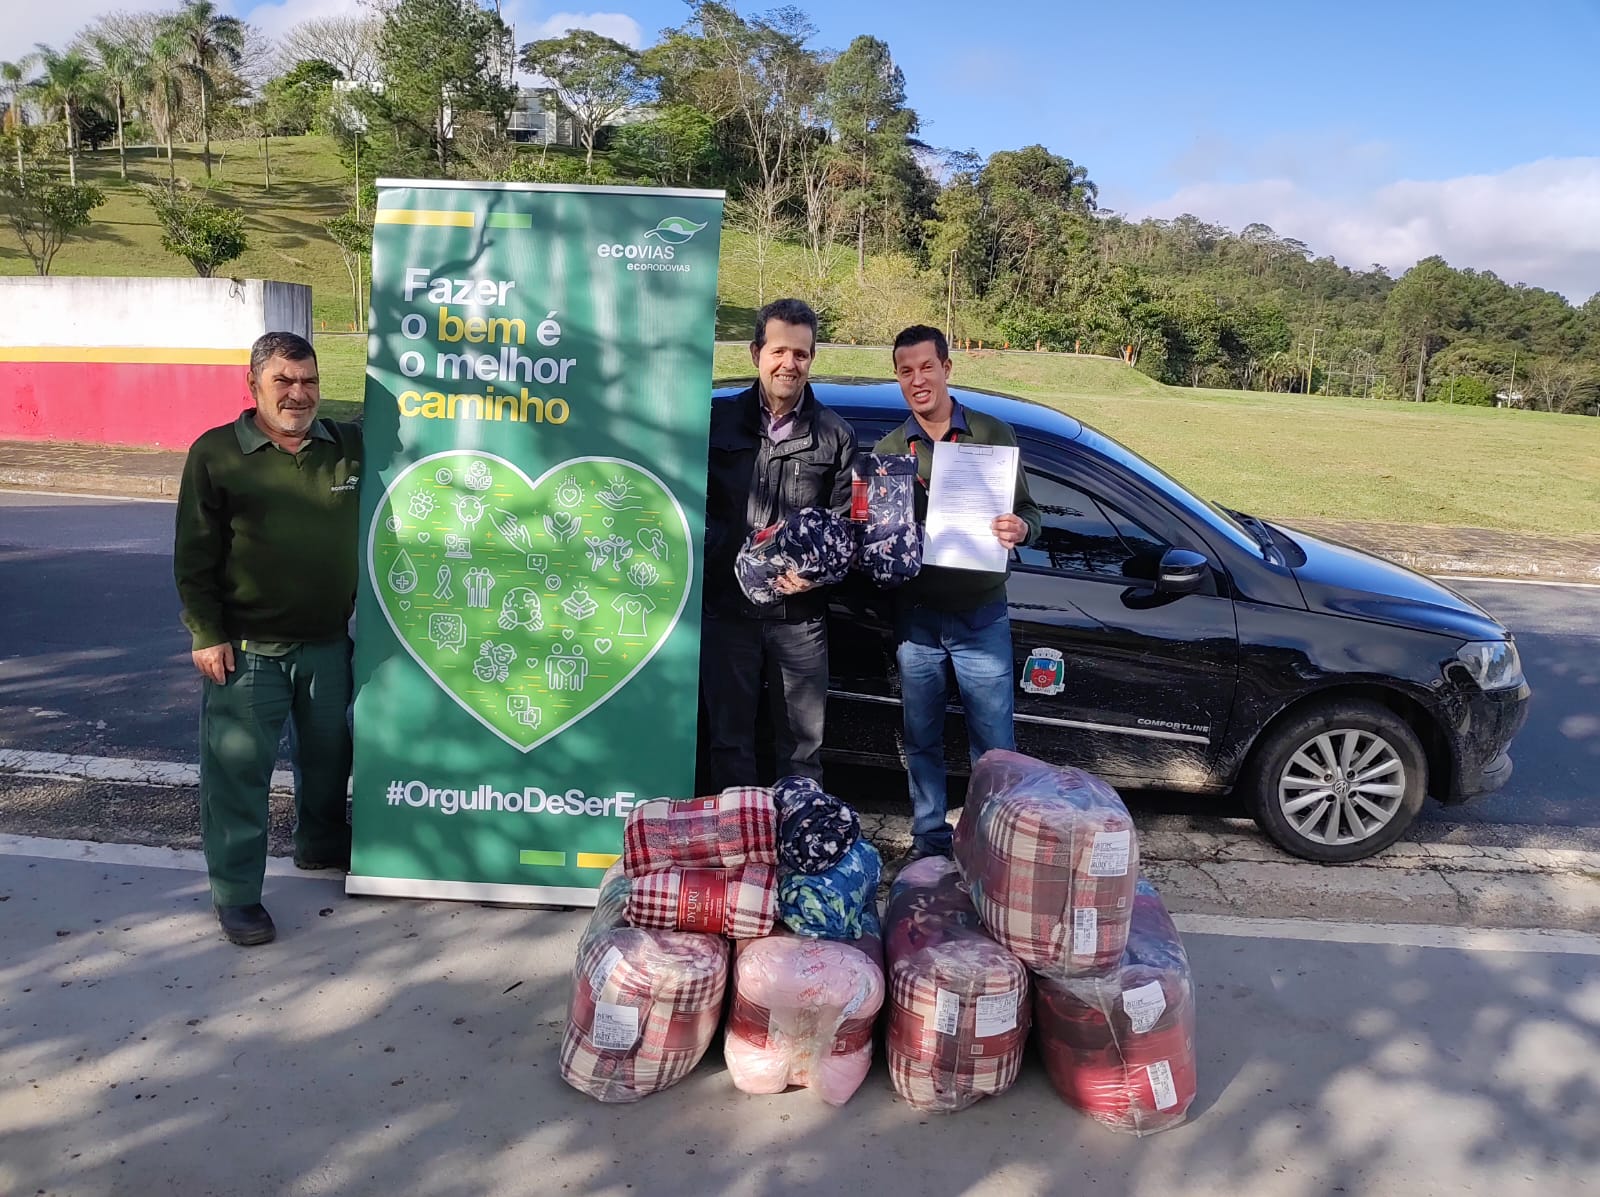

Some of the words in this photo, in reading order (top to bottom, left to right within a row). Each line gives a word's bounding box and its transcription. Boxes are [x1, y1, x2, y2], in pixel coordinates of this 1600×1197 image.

[404, 267, 515, 307] Fazer
[400, 313, 427, 341] o
[437, 306, 526, 345] bem
[536, 311, 562, 347] é
[399, 350, 425, 378] o
[436, 347, 577, 384] melhor
[398, 386, 570, 425] caminho
[1137, 718, 1209, 732] COMFORTLINE
[686, 890, 700, 924] DYURI
